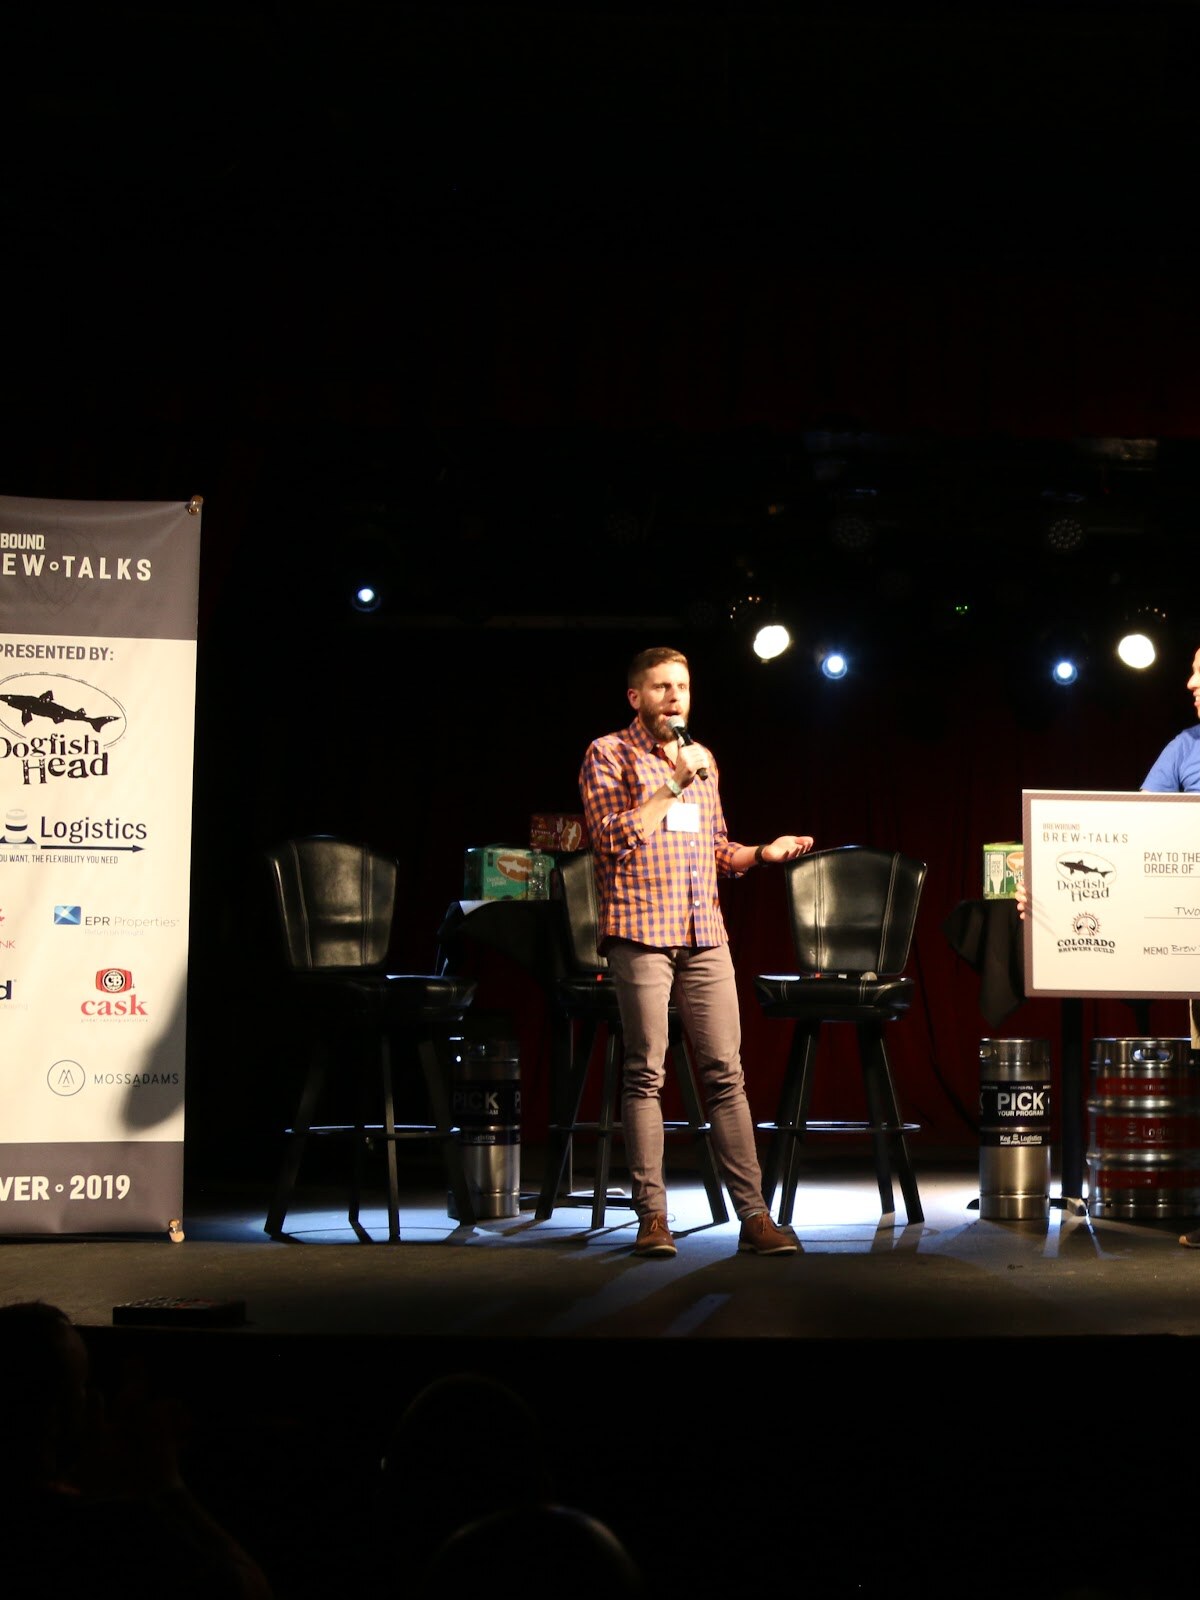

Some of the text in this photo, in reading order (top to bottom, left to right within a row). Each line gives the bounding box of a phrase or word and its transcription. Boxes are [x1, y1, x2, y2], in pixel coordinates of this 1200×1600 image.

[62, 555, 152, 581] TALKS
[90, 647, 114, 661] BY:
[22, 752, 108, 785] Head
[41, 816, 147, 844] Logistics
[1043, 832, 1128, 843] BREW TALKS
[32, 854, 44, 863] THE
[45, 855, 84, 864] FLEXIBILITY
[87, 856, 99, 864] YOU
[101, 856, 118, 864] NEED
[1144, 852, 1200, 863] PAY TO THE
[1144, 864, 1194, 874] ORDER OF
[1057, 878, 1106, 891] Dogfish
[1071, 887, 1109, 902] Head
[1174, 906, 1200, 916] Two
[85, 916, 176, 928] EPR Properties
[1057, 938, 1115, 948] COLORADO
[1143, 946, 1169, 955] MEMO
[1171, 944, 1197, 953] Brew
[81, 994, 149, 1016] cask
[94, 1073, 179, 1084] MOSSADAMS
[997, 1092, 1045, 1110] PICK
[70, 1174, 131, 1200] 2019
